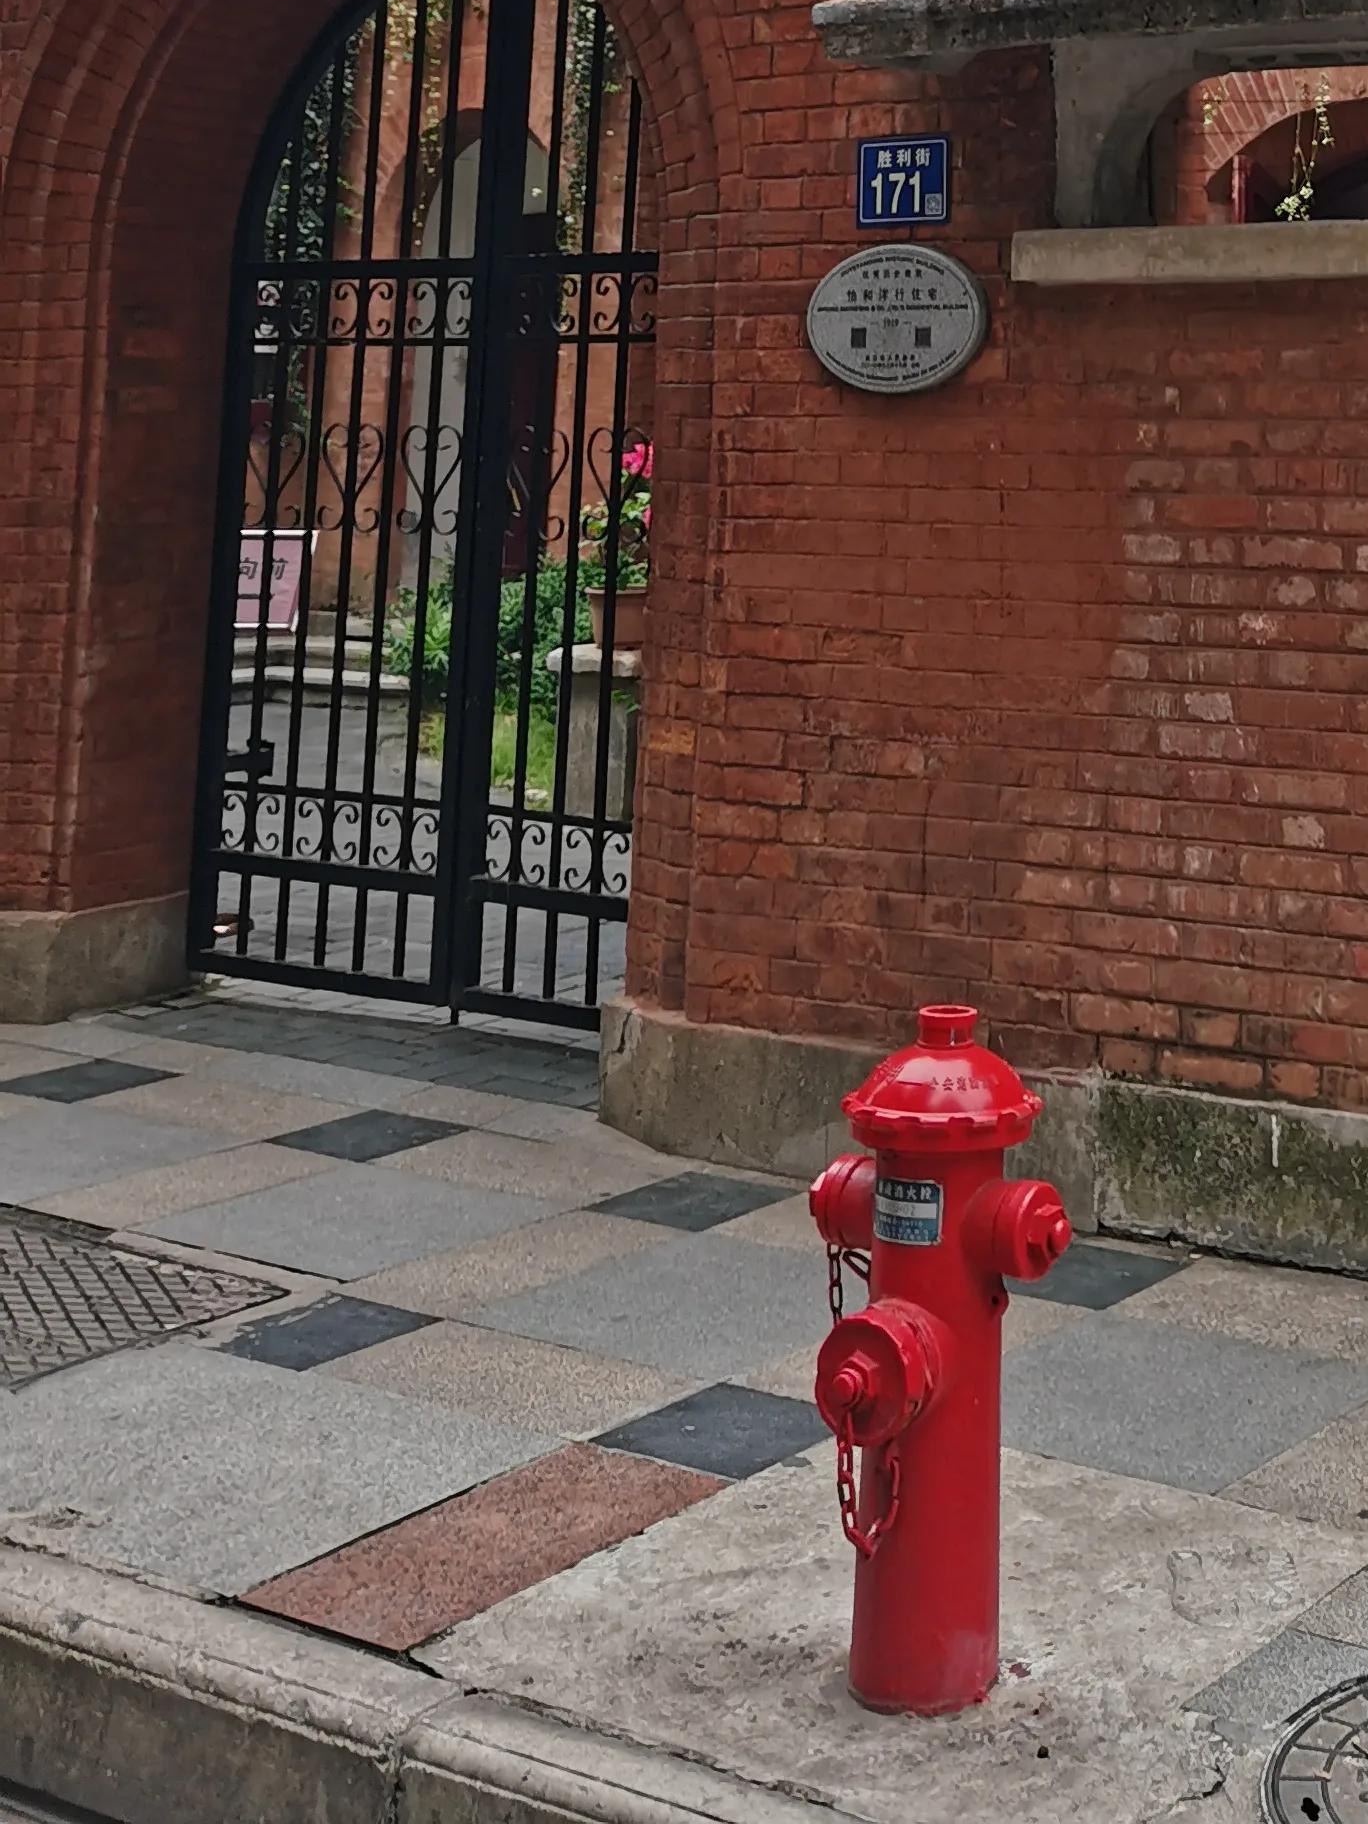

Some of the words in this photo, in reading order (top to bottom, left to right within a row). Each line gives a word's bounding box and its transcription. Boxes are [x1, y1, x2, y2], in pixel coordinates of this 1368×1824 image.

[877, 147, 931, 169] 胜利街
[871, 170, 920, 215] 171
